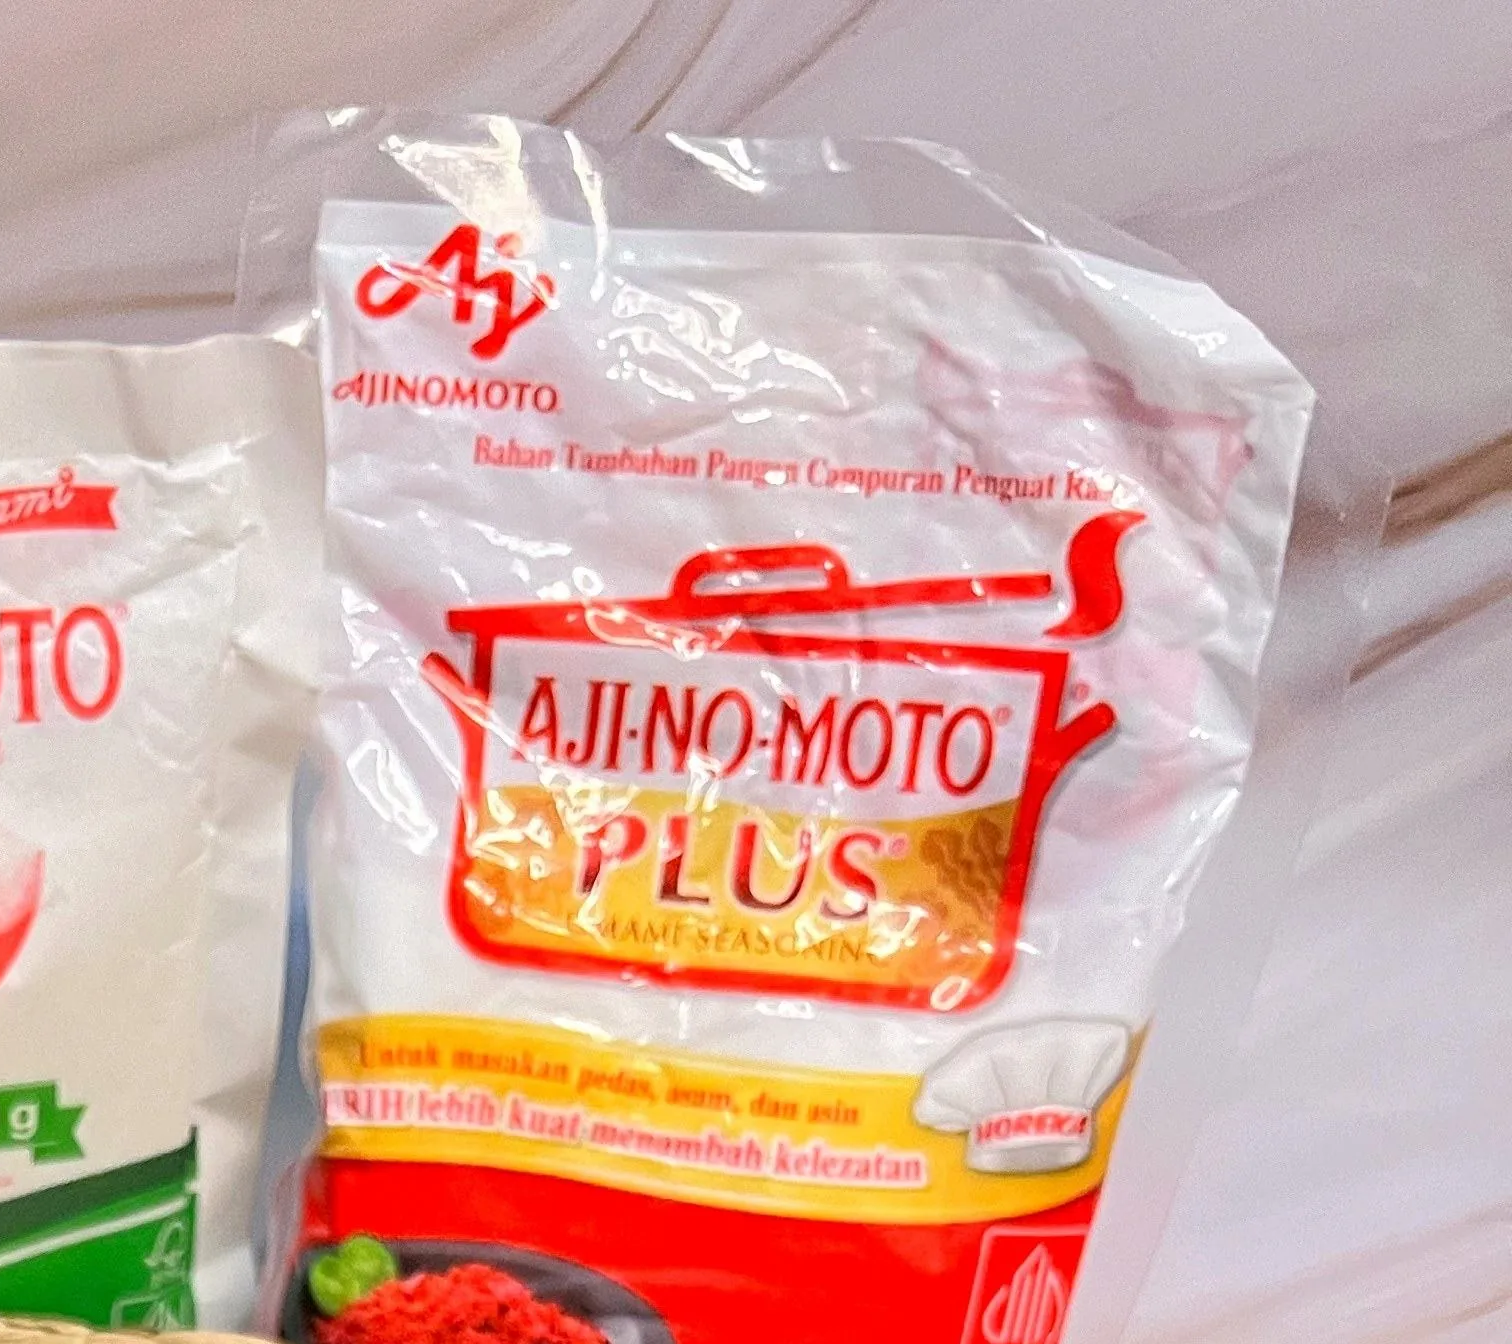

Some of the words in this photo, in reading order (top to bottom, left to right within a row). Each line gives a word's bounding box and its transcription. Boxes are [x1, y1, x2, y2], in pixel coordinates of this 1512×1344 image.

[332, 370, 558, 413] AJINOMOTO
[563, 440, 699, 478] Tambahan
[806, 457, 945, 498] Campuran
[952, 461, 1056, 506] Penguat
[578, 814, 883, 921] PLUS
[7, 1101, 41, 1141] g
[750, 1092, 799, 1122] dan
[417, 1087, 497, 1126] lebih
[508, 1096, 583, 1141] kuat
[590, 1119, 764, 1172] menambah
[773, 1142, 923, 1183] kelezatan
